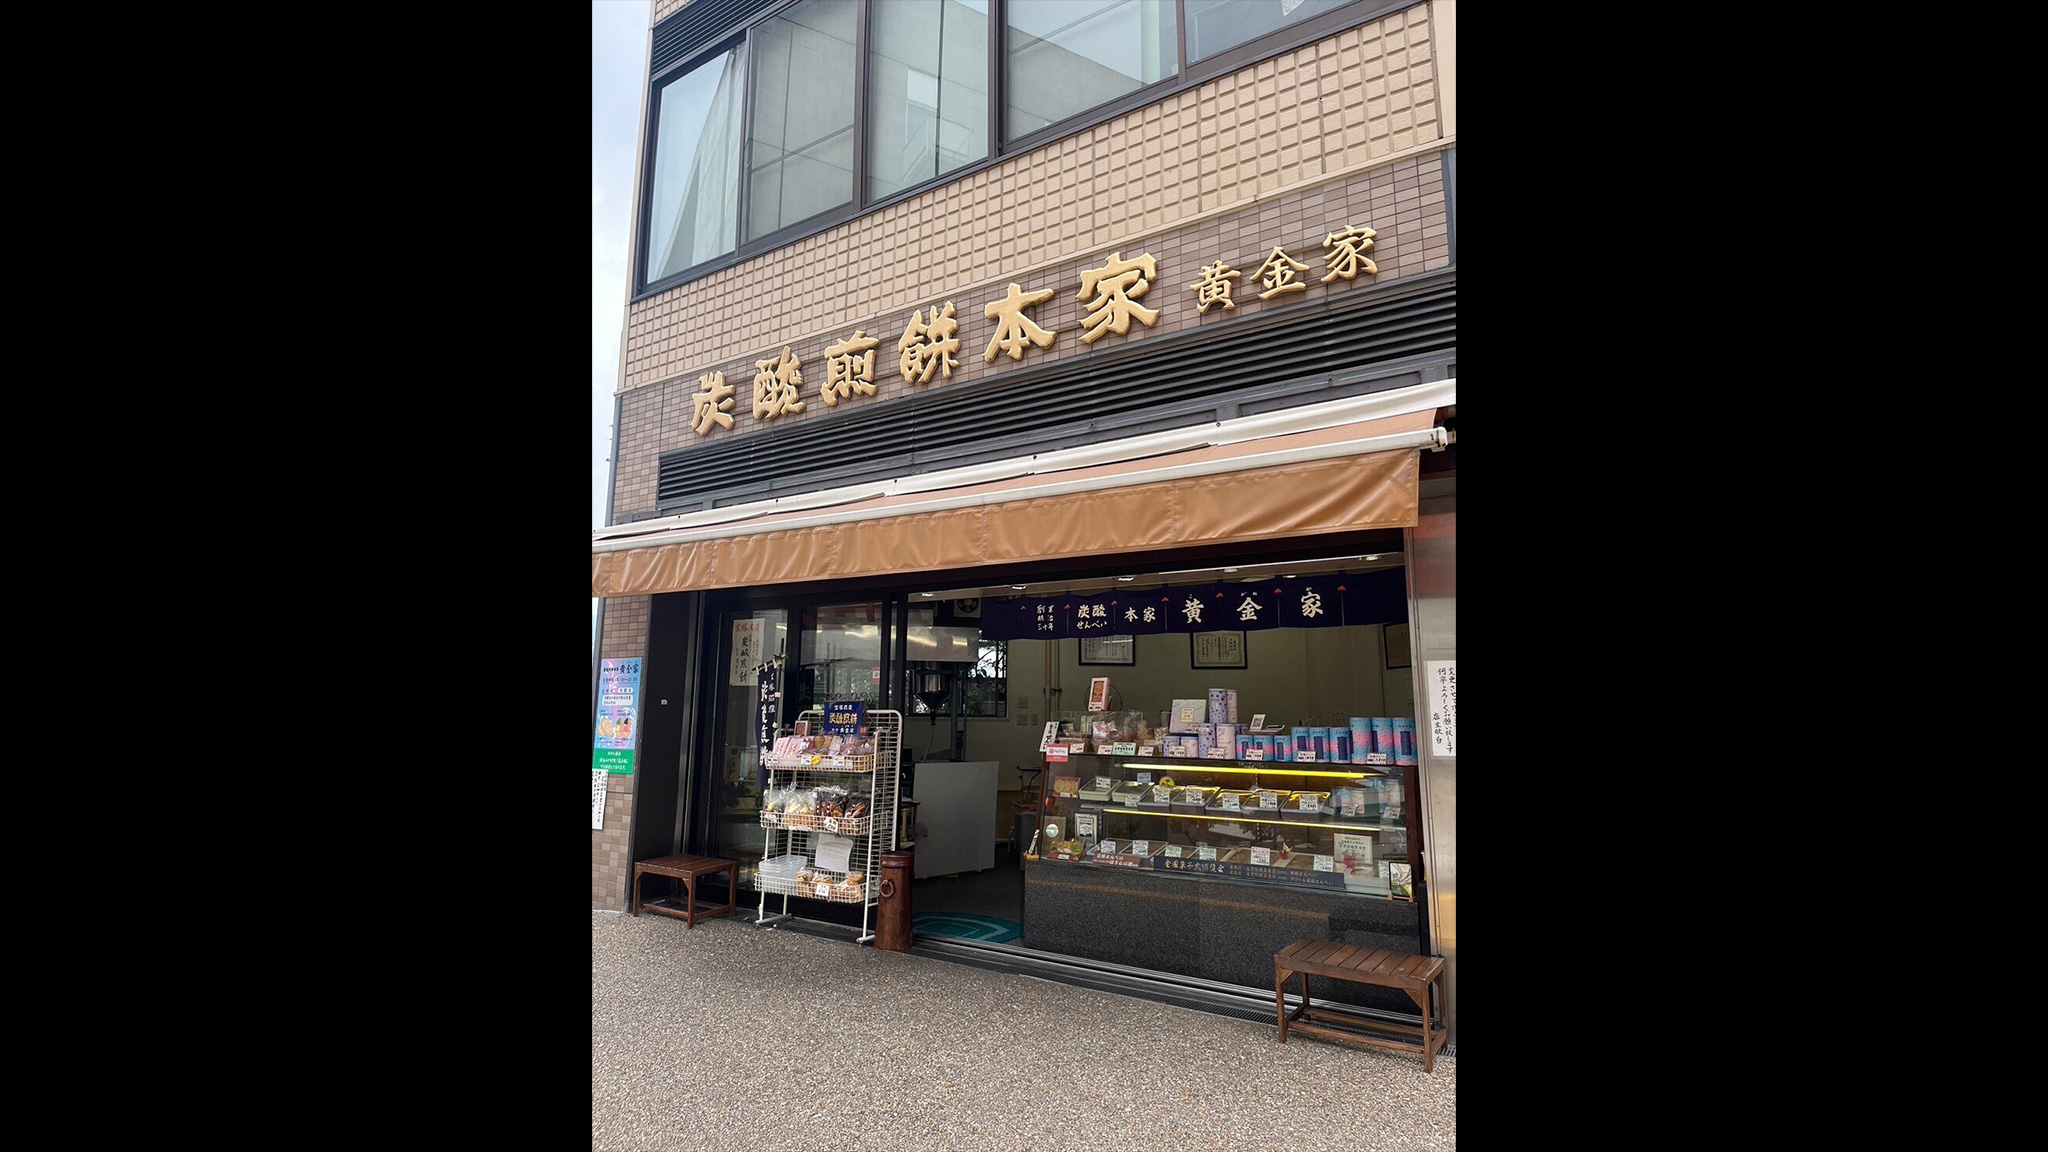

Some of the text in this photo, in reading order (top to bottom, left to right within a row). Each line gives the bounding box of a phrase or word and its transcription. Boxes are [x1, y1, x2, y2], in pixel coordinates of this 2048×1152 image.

[690, 225, 1379, 437] 炭酸煎餅本家 黄金家
[1078, 604, 1107, 619] 炭酸
[1124, 606, 1156, 622] 本家
[1076, 620, 1108, 630] せんべい
